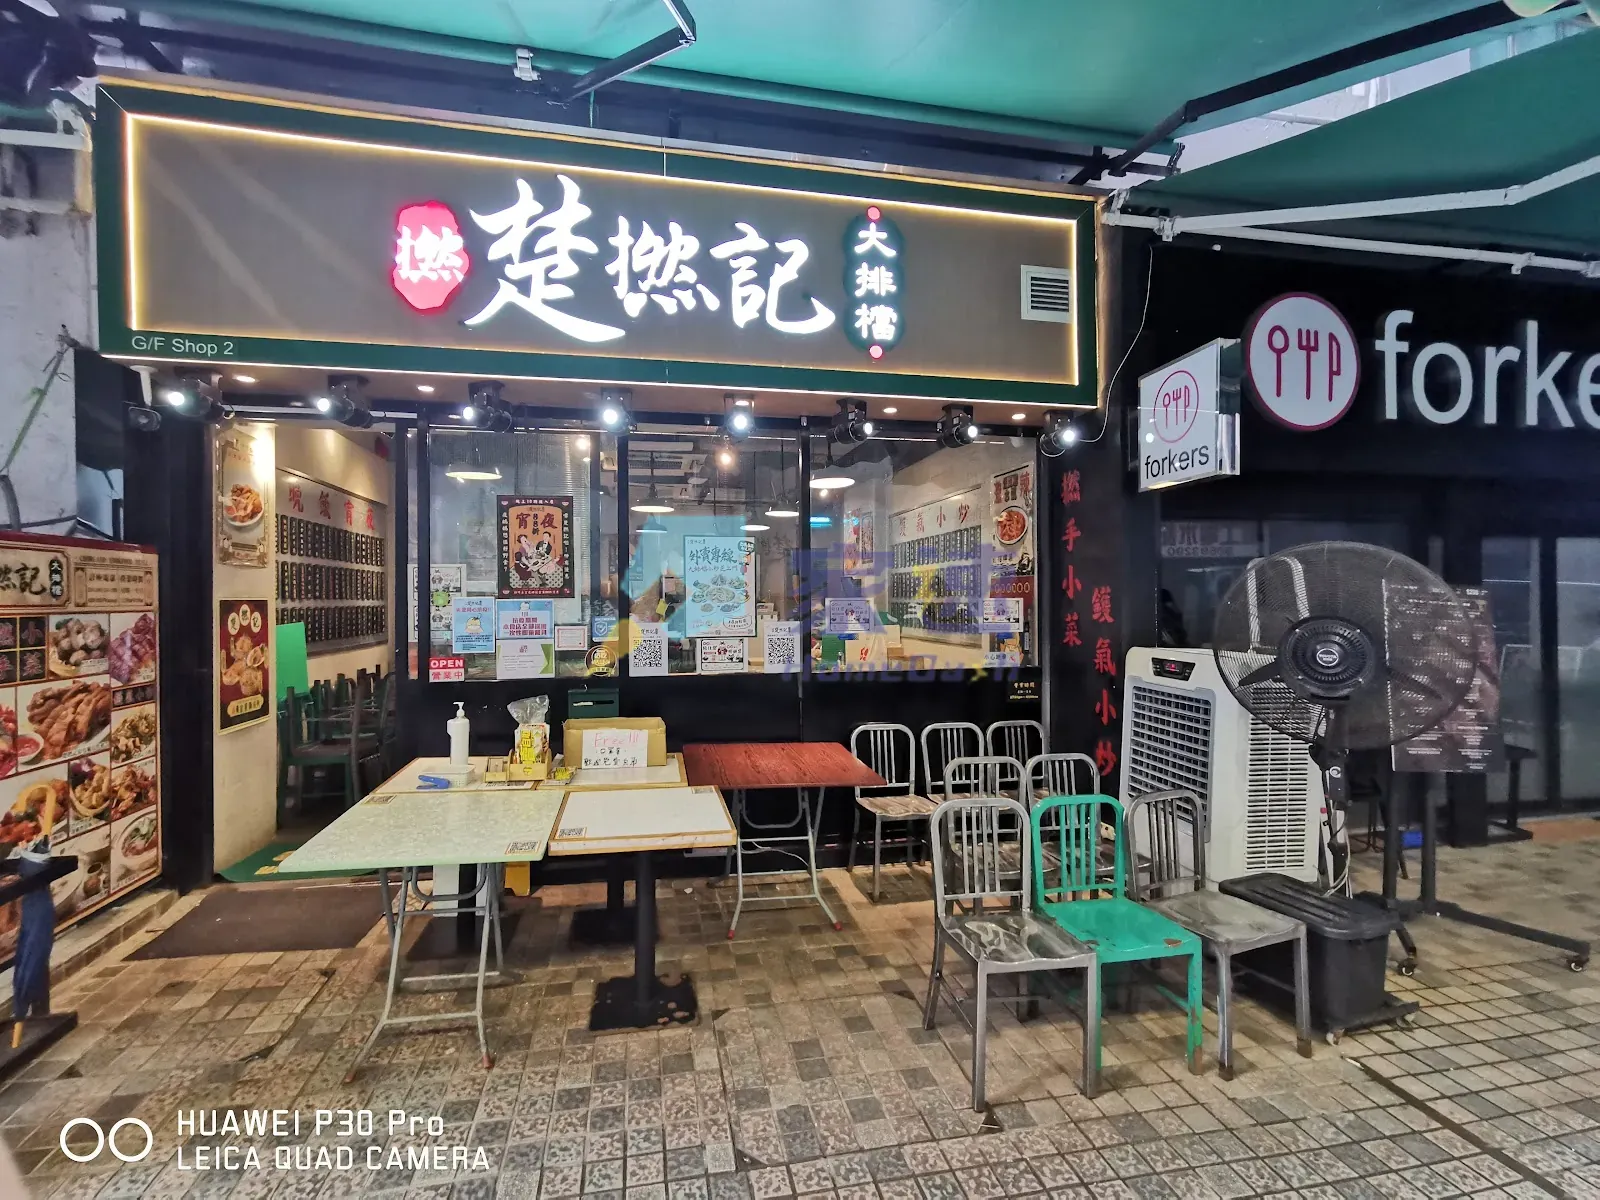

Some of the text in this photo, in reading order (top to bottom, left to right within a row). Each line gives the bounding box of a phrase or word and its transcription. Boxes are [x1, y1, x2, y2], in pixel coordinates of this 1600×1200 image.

[853, 221, 898, 341] 大排檔
[131, 335, 234, 358] G/F Shop 2
[1144, 443, 1210, 481] forkers
[430, 659, 464, 669] OPEN
[431, 671, 463, 681] 營業中
[1091, 585, 1117, 777] 鑊氣小炒
